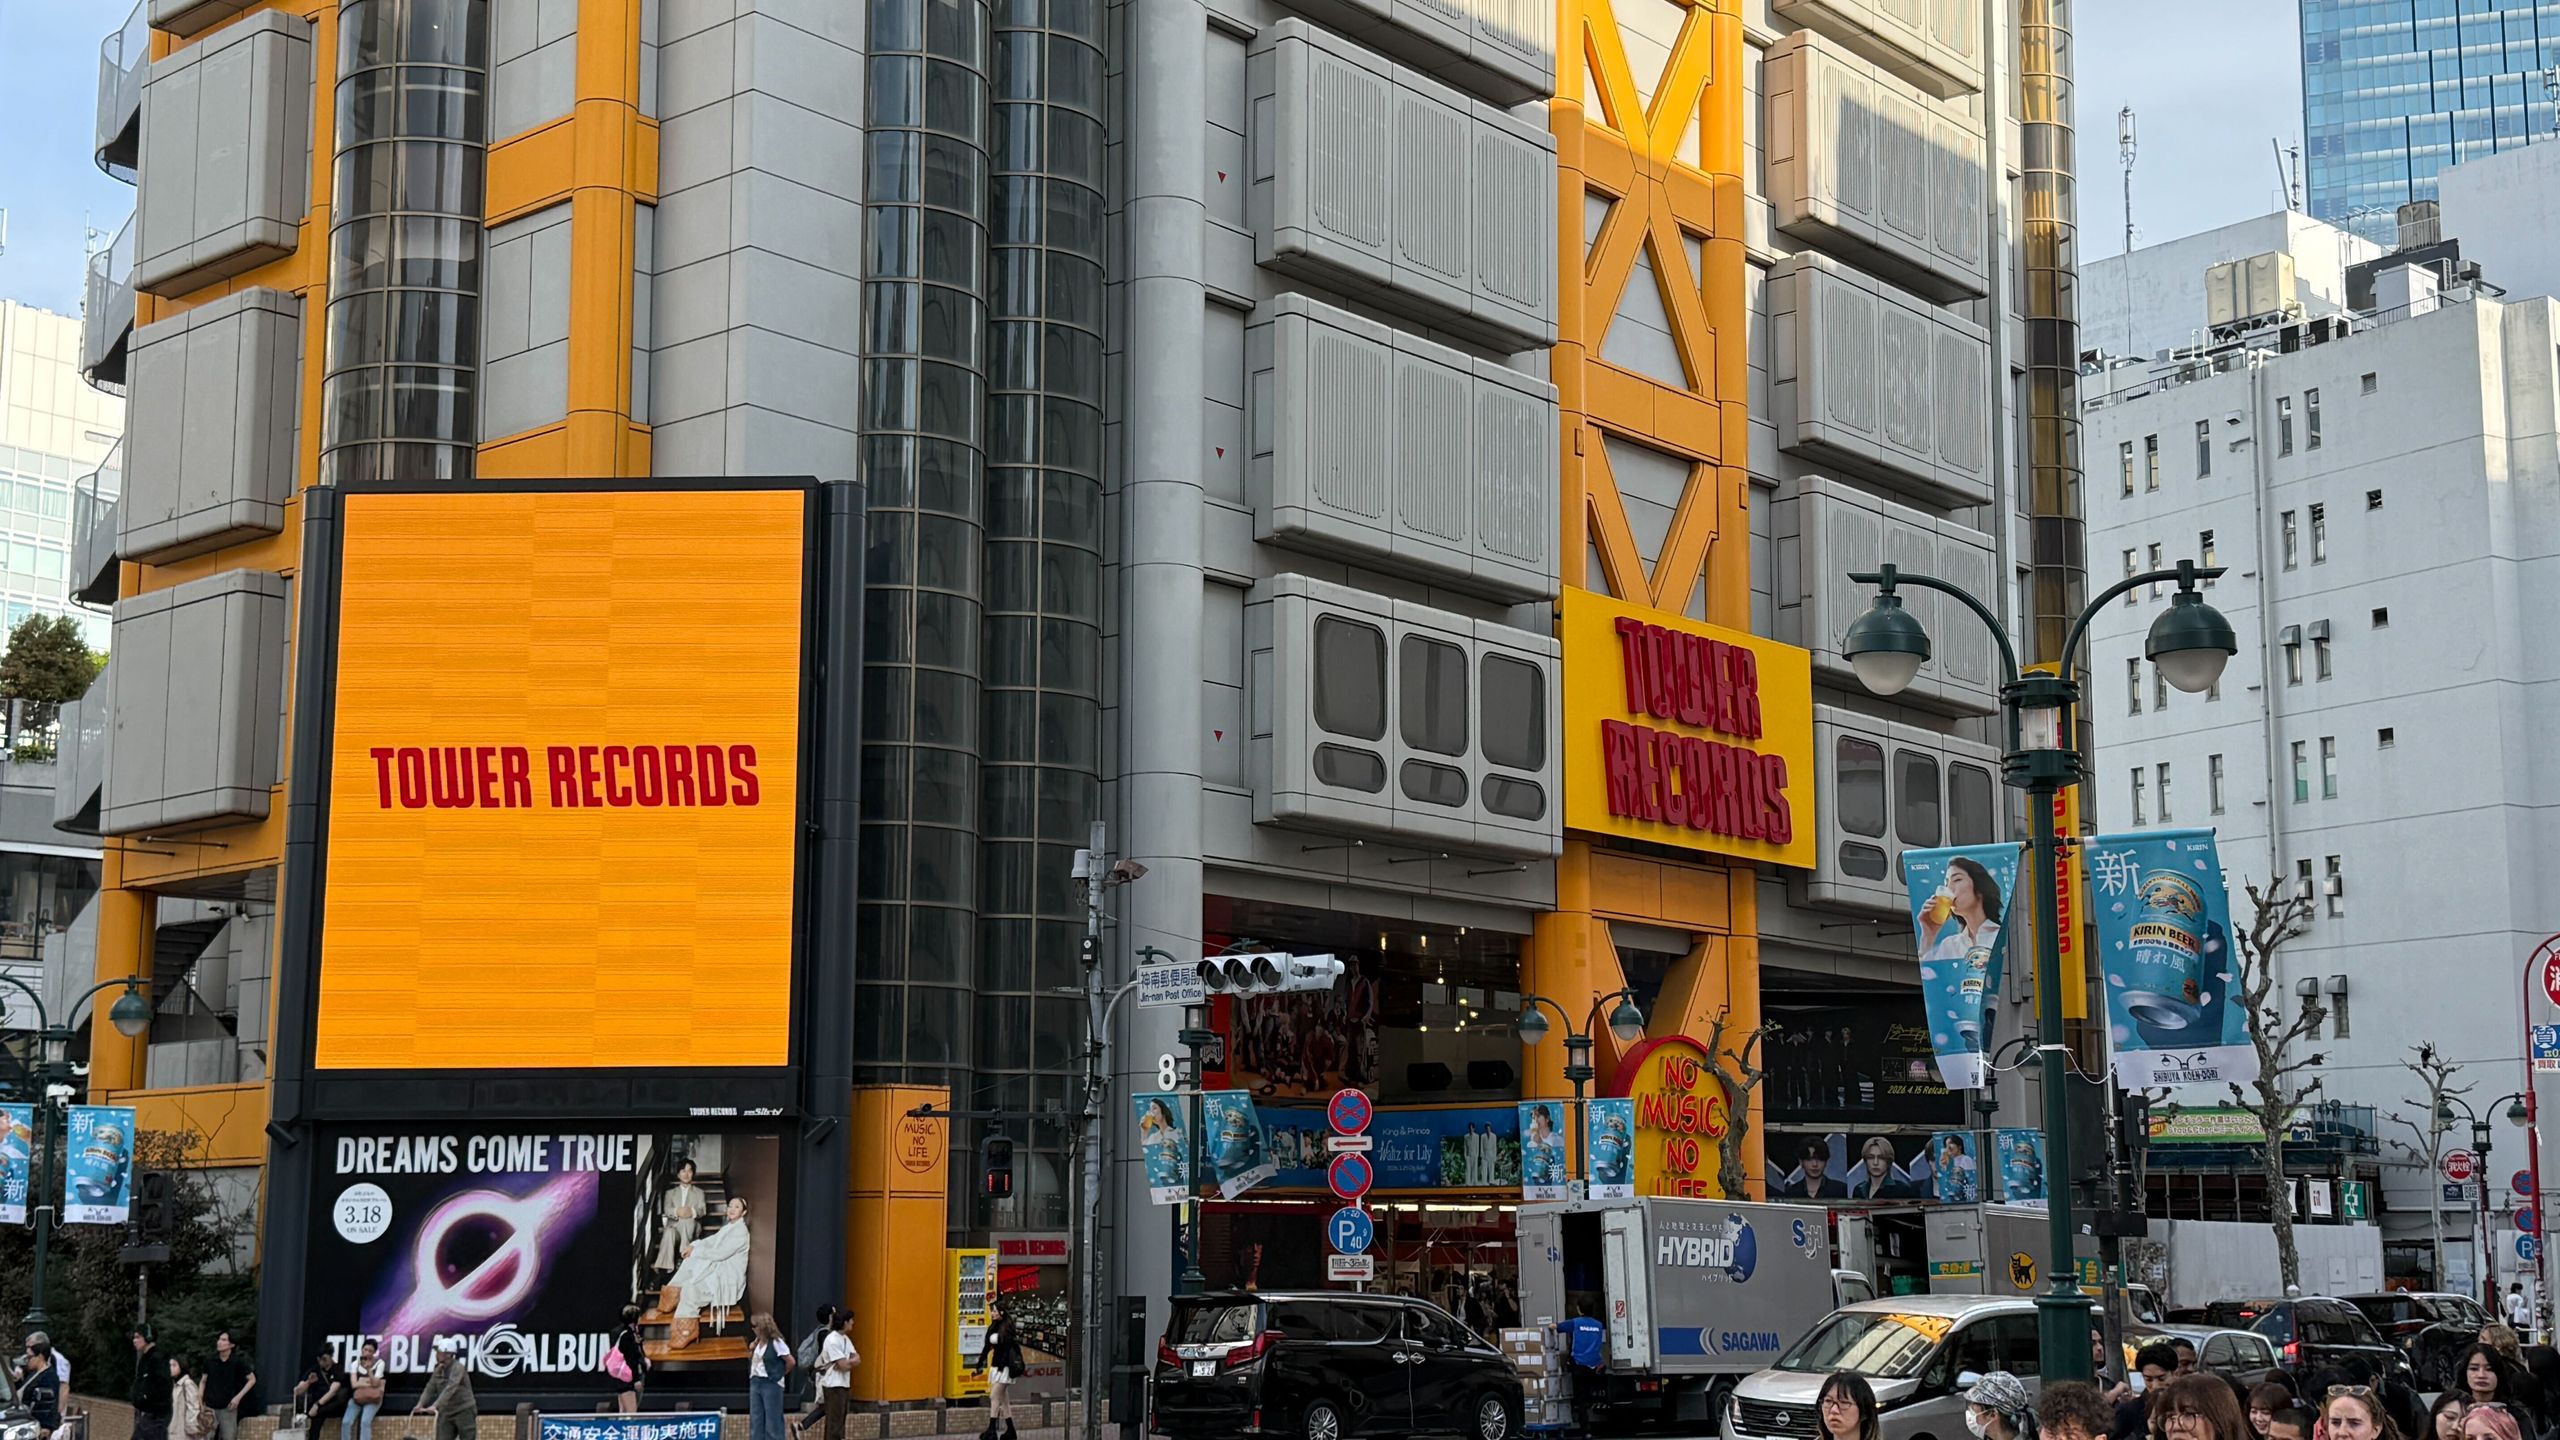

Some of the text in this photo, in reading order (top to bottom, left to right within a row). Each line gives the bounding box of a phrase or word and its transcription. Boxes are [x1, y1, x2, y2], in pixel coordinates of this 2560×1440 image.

[1614, 616, 1763, 740] TOWER
[370, 744, 760, 809] TOWER RECORDS
[1600, 718, 1793, 845] RECORDS
[2186, 843, 2209, 852] KIRIN
[2094, 849, 2141, 899] 新
[2133, 924, 2197, 949] KIRIN BEER
[2136, 949, 2186, 974] 晴れ風
[1141, 967, 1200, 990] 神南郵便局前
[1141, 988, 1203, 1002] Jin-nan Post Office
[1158, 1053, 1177, 1091] 8
[1665, 1056, 1698, 1090] NO
[2153, 1071, 2180, 1082] SHIBUYA
[71, 1112, 94, 1136] 新
[1589, 1105, 1606, 1124] 新
[913, 1136, 925, 1145] NO
[1377, 1140, 1402, 1161] Waltz
[336, 1134, 633, 1174] DREAMS COME TRUE
[1666, 1138, 1700, 1174] NO
[1549, 1163, 1564, 1181] 新
[2448, 1161, 2471, 1173] 消火栓
[4, 1178, 24, 1200] 新
[345, 1205, 381, 1223] 3.18
[1339, 1220, 1355, 1249] P
[1657, 1235, 1735, 1269] HYBRID
[1721, 1332, 1781, 1351] SAGAWA
[1046, 1366, 1063, 1376] LIFE
[543, 1420, 716, 1440] 交通安全運動実施中
